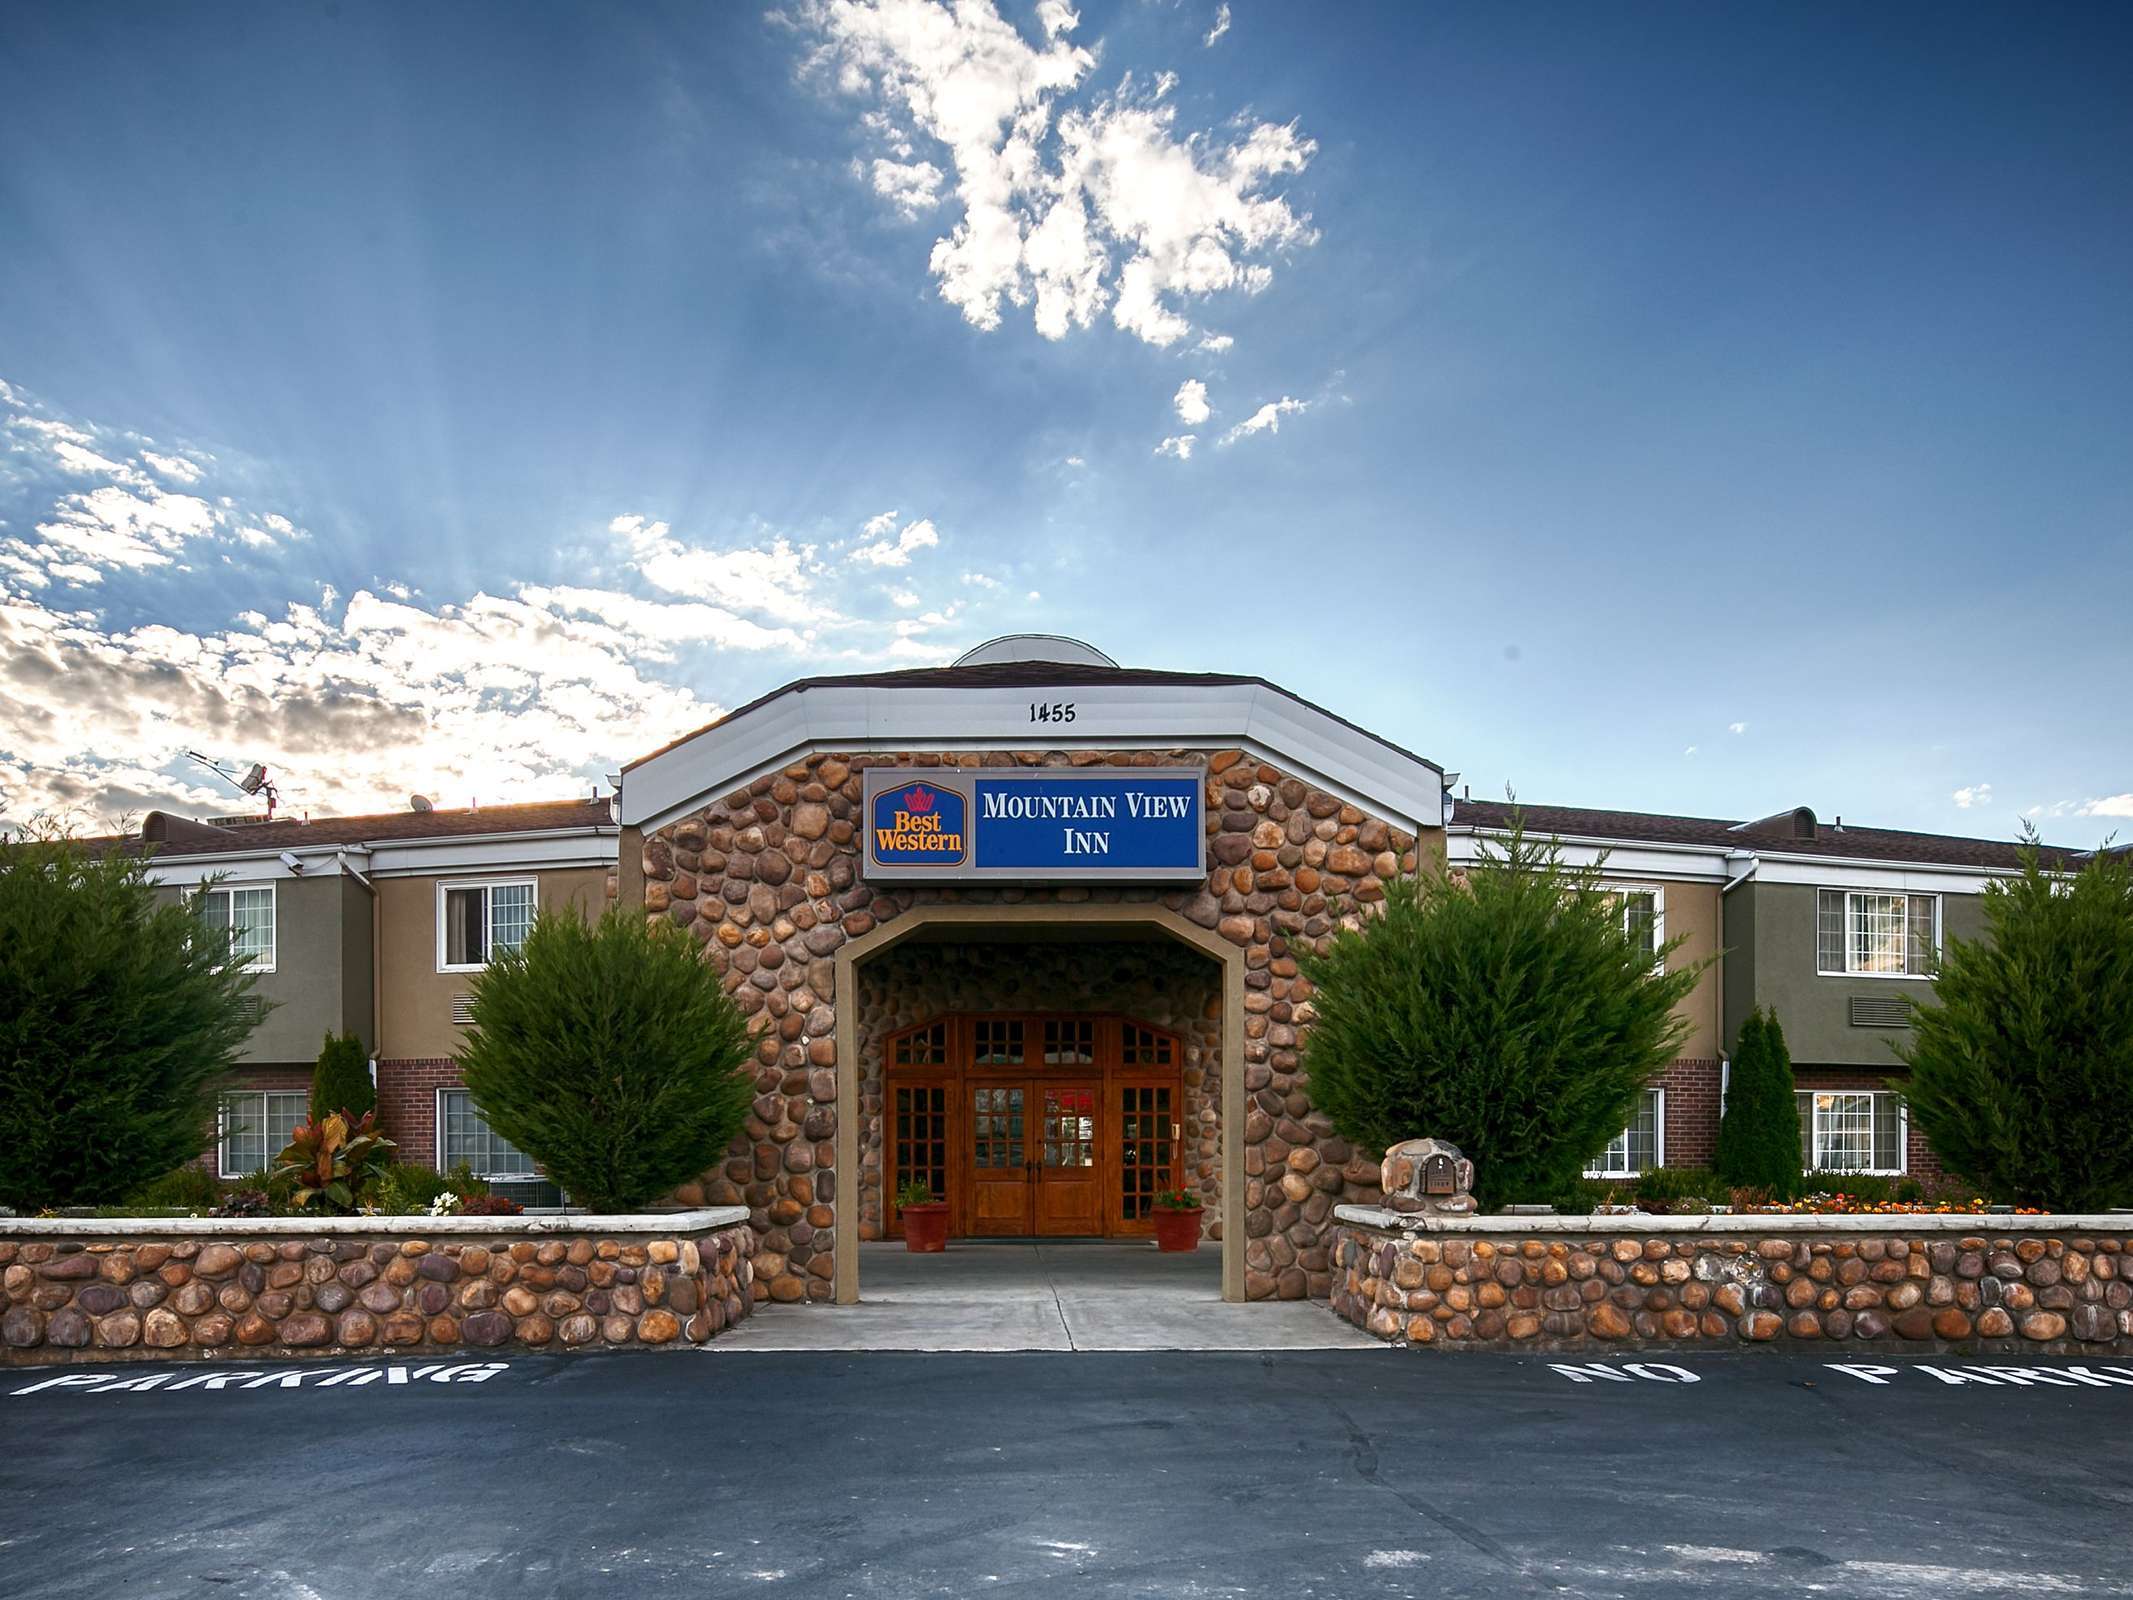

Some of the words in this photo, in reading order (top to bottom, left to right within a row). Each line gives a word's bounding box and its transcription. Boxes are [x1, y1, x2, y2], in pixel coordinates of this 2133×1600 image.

[1030, 702, 1076, 723] 1455
[983, 792, 1116, 819] MOUNTAIN
[1125, 792, 1191, 818] VIEW
[894, 810, 942, 832] Best
[876, 829, 962, 851] Western
[1063, 828, 1110, 854] INN
[9, 1362, 510, 1395] PARKING
[1547, 1363, 1701, 1383] NO
